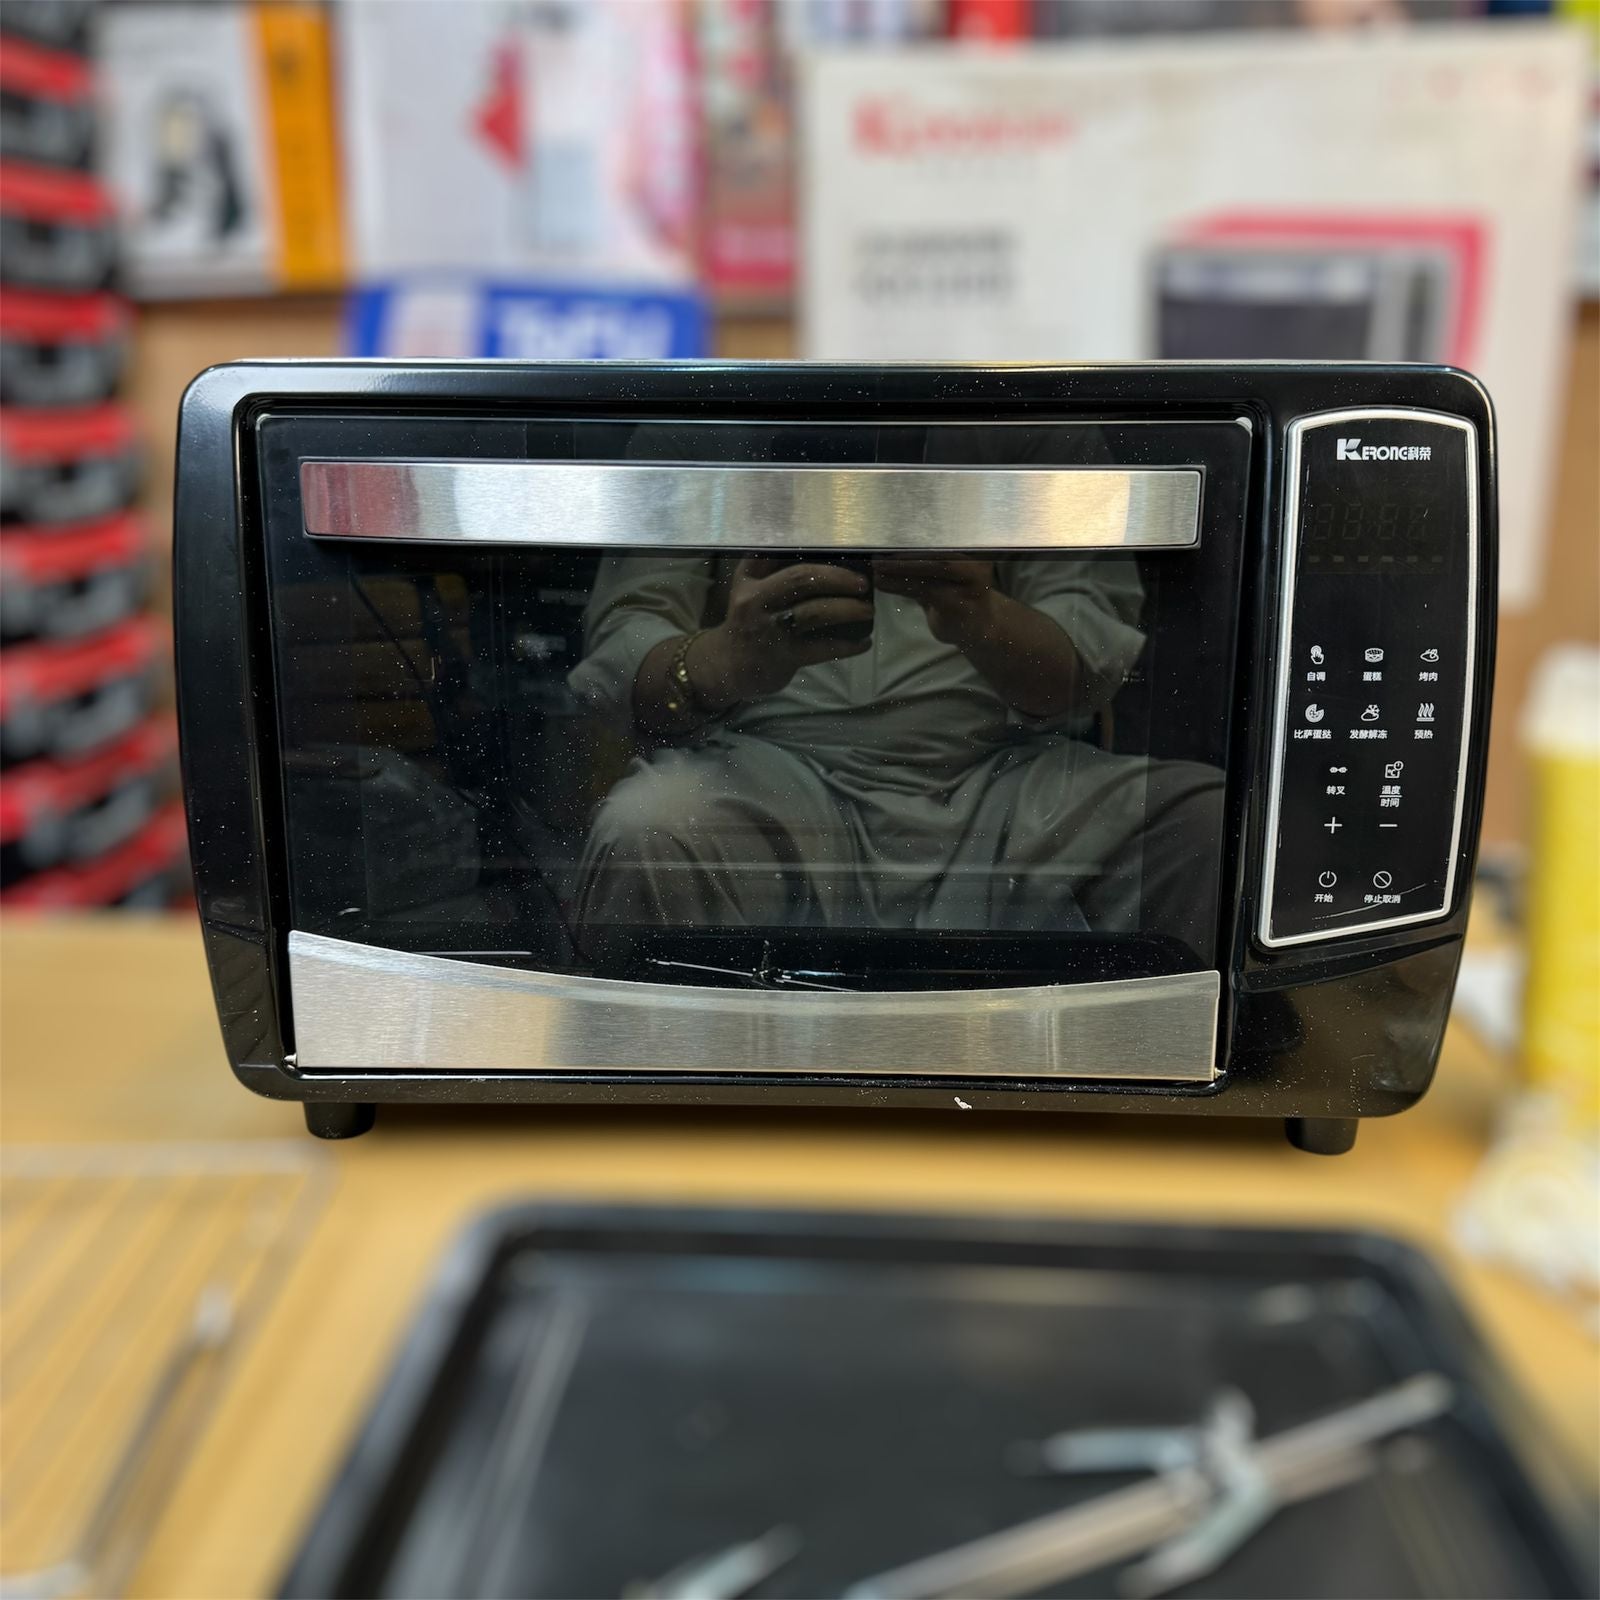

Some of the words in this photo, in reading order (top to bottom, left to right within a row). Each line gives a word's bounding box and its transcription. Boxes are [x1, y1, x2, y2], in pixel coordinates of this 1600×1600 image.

[1306, 671, 1327, 682] 自调
[1362, 671, 1383, 682] 蛋糕
[1418, 671, 1439, 682] 烤肉
[1293, 729, 1332, 740] 比萨蛋挞
[1349, 729, 1388, 740] 发酵解冻
[1413, 729, 1434, 740] 预热
[1326, 785, 1346, 796] 转叉
[1381, 785, 1401, 795] 温度
[1380, 798, 1400, 808] 时间
[1314, 893, 1334, 903] 开始
[1363, 893, 1401, 904] 停止取消
